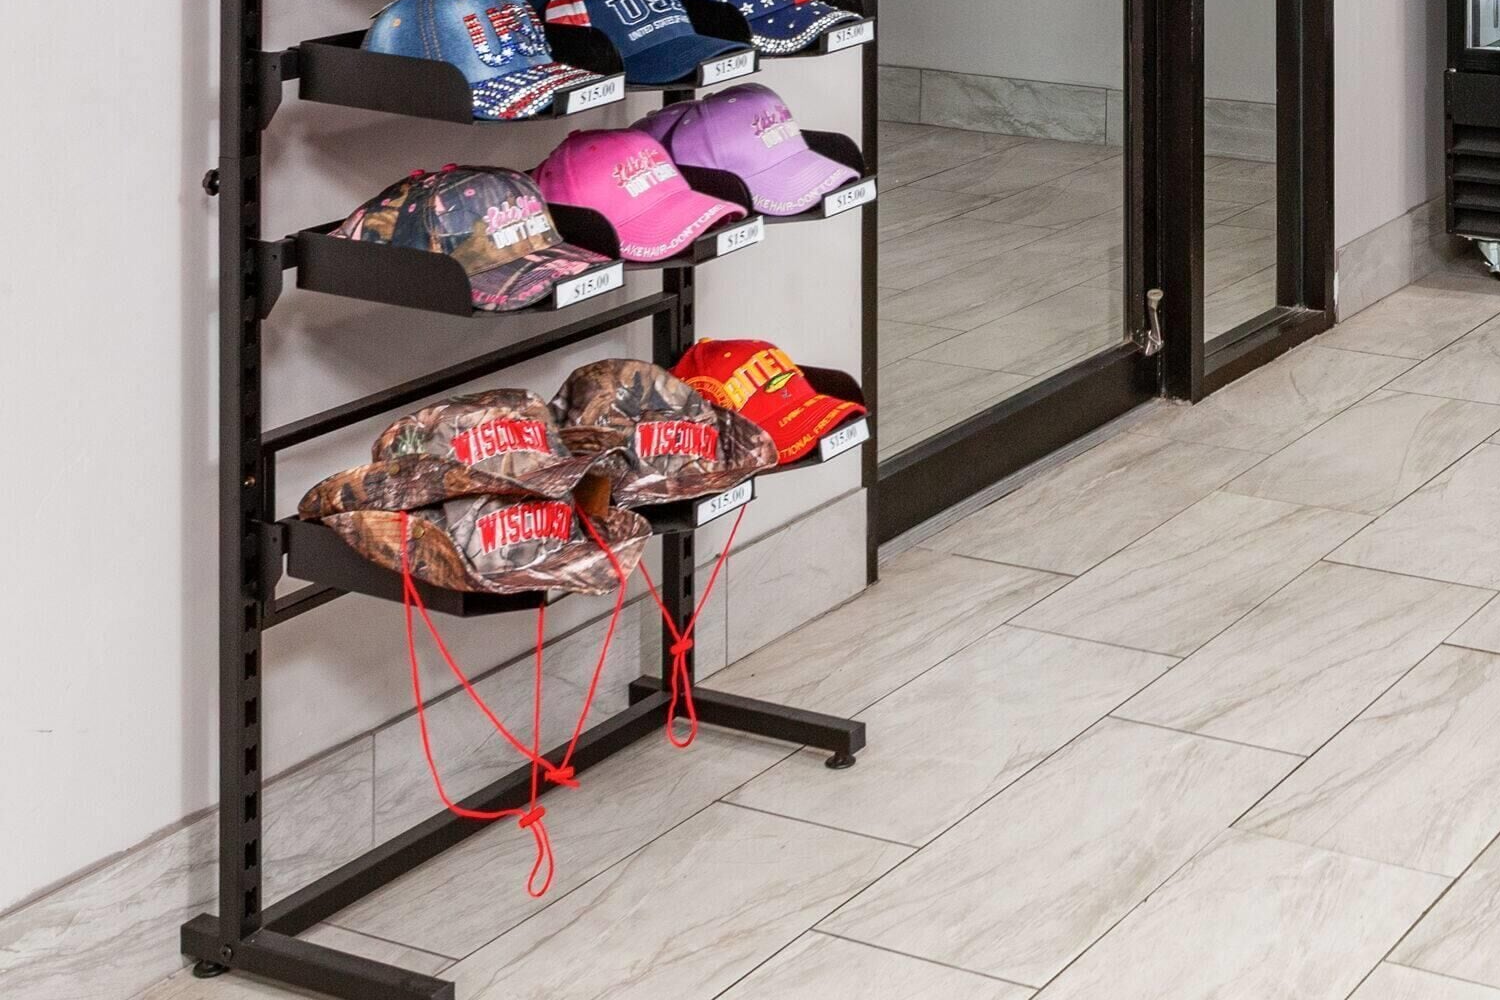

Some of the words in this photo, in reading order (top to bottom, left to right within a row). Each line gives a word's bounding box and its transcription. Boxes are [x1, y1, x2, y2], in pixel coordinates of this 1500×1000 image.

[835, 24, 865, 43] $15.00
[715, 55, 747, 75] $15.00
[580, 84, 615, 104] $15.00
[752, 194, 769, 209] AKE
[837, 187, 866, 207] $15.00
[727, 226, 758, 248] $15.00
[573, 274, 610, 299] $15.00
[829, 425, 858, 450] $15.00
[710, 486, 746, 513] $15.00
